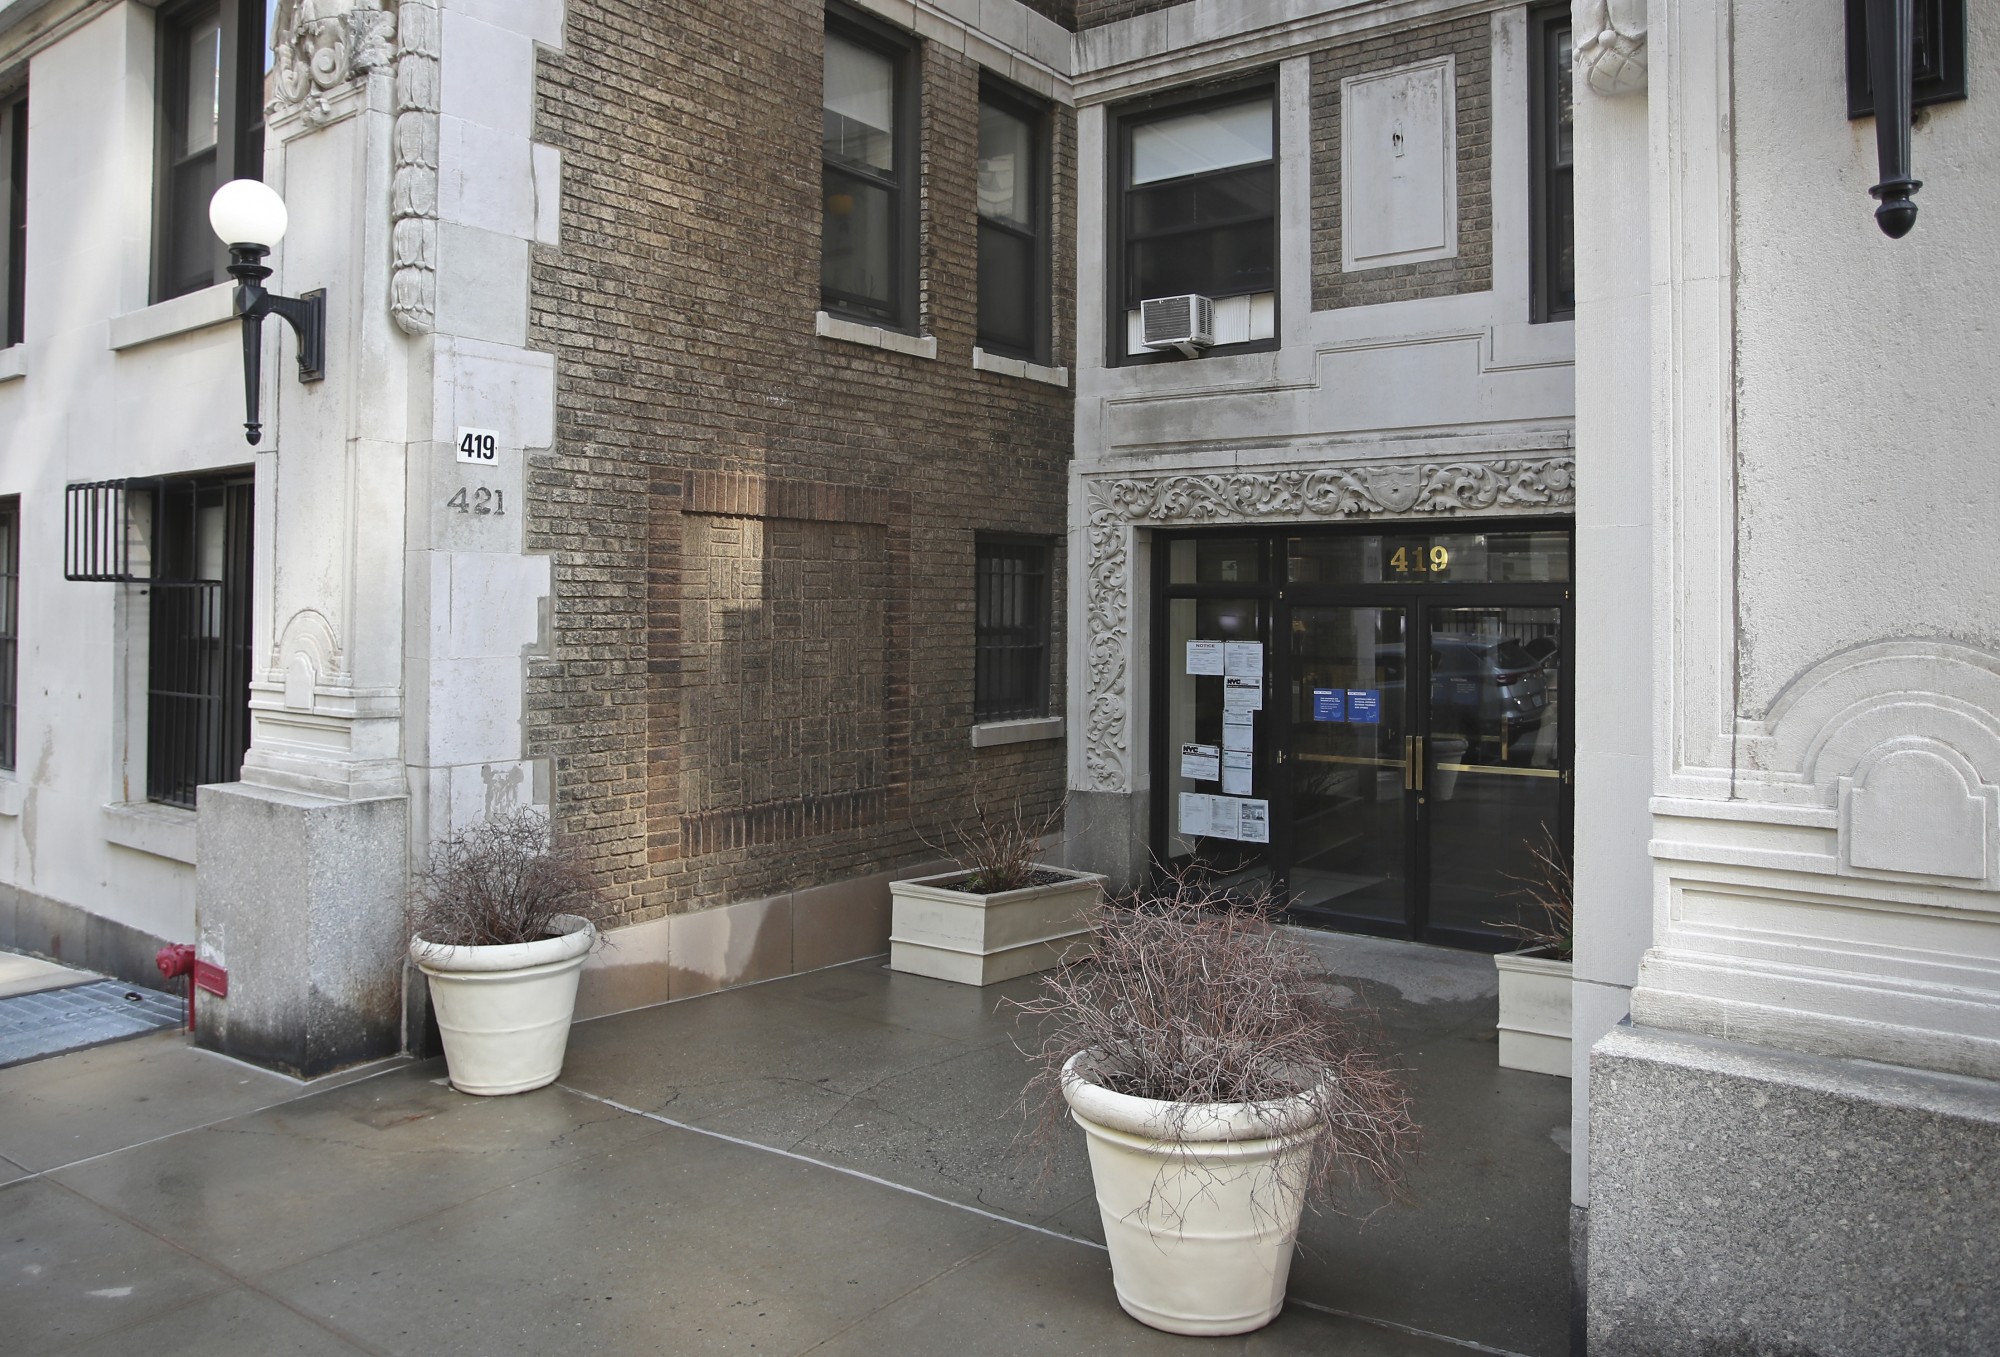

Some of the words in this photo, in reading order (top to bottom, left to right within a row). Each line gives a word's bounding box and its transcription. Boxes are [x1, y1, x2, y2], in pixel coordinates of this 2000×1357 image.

[461, 433, 495, 459] 419
[447, 487, 505, 515] 421
[1390, 546, 1448, 572] 419
[1182, 745, 1199, 753] NYC
